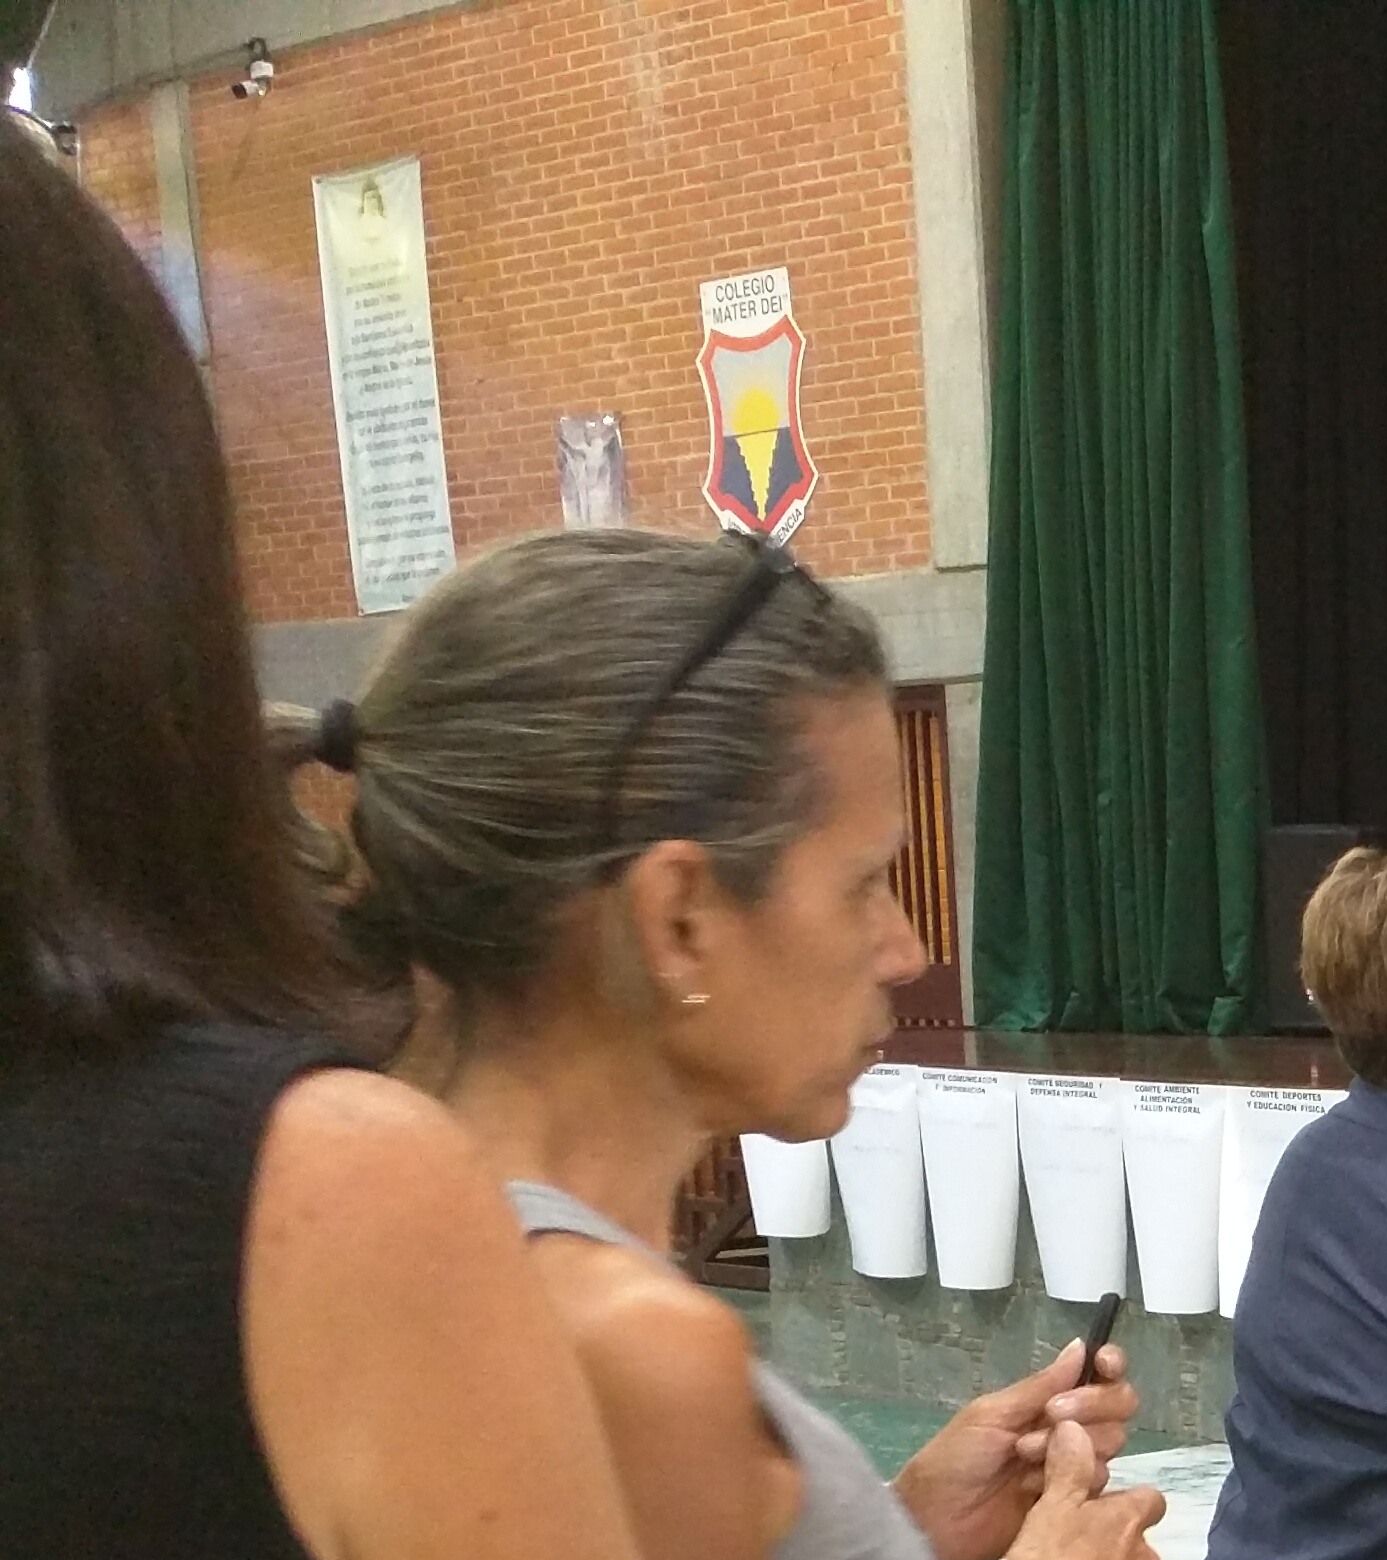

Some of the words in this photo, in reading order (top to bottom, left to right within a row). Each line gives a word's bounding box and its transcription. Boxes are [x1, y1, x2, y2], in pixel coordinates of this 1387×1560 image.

[715, 274, 775, 303] COLEGIO
[1164, 1085, 1200, 1095] AMBIENTE
[1282, 1091, 1322, 1102] DEPORTES
[1140, 1104, 1163, 1112] SALUD
[1165, 1105, 1201, 1114] INTEGRAL
